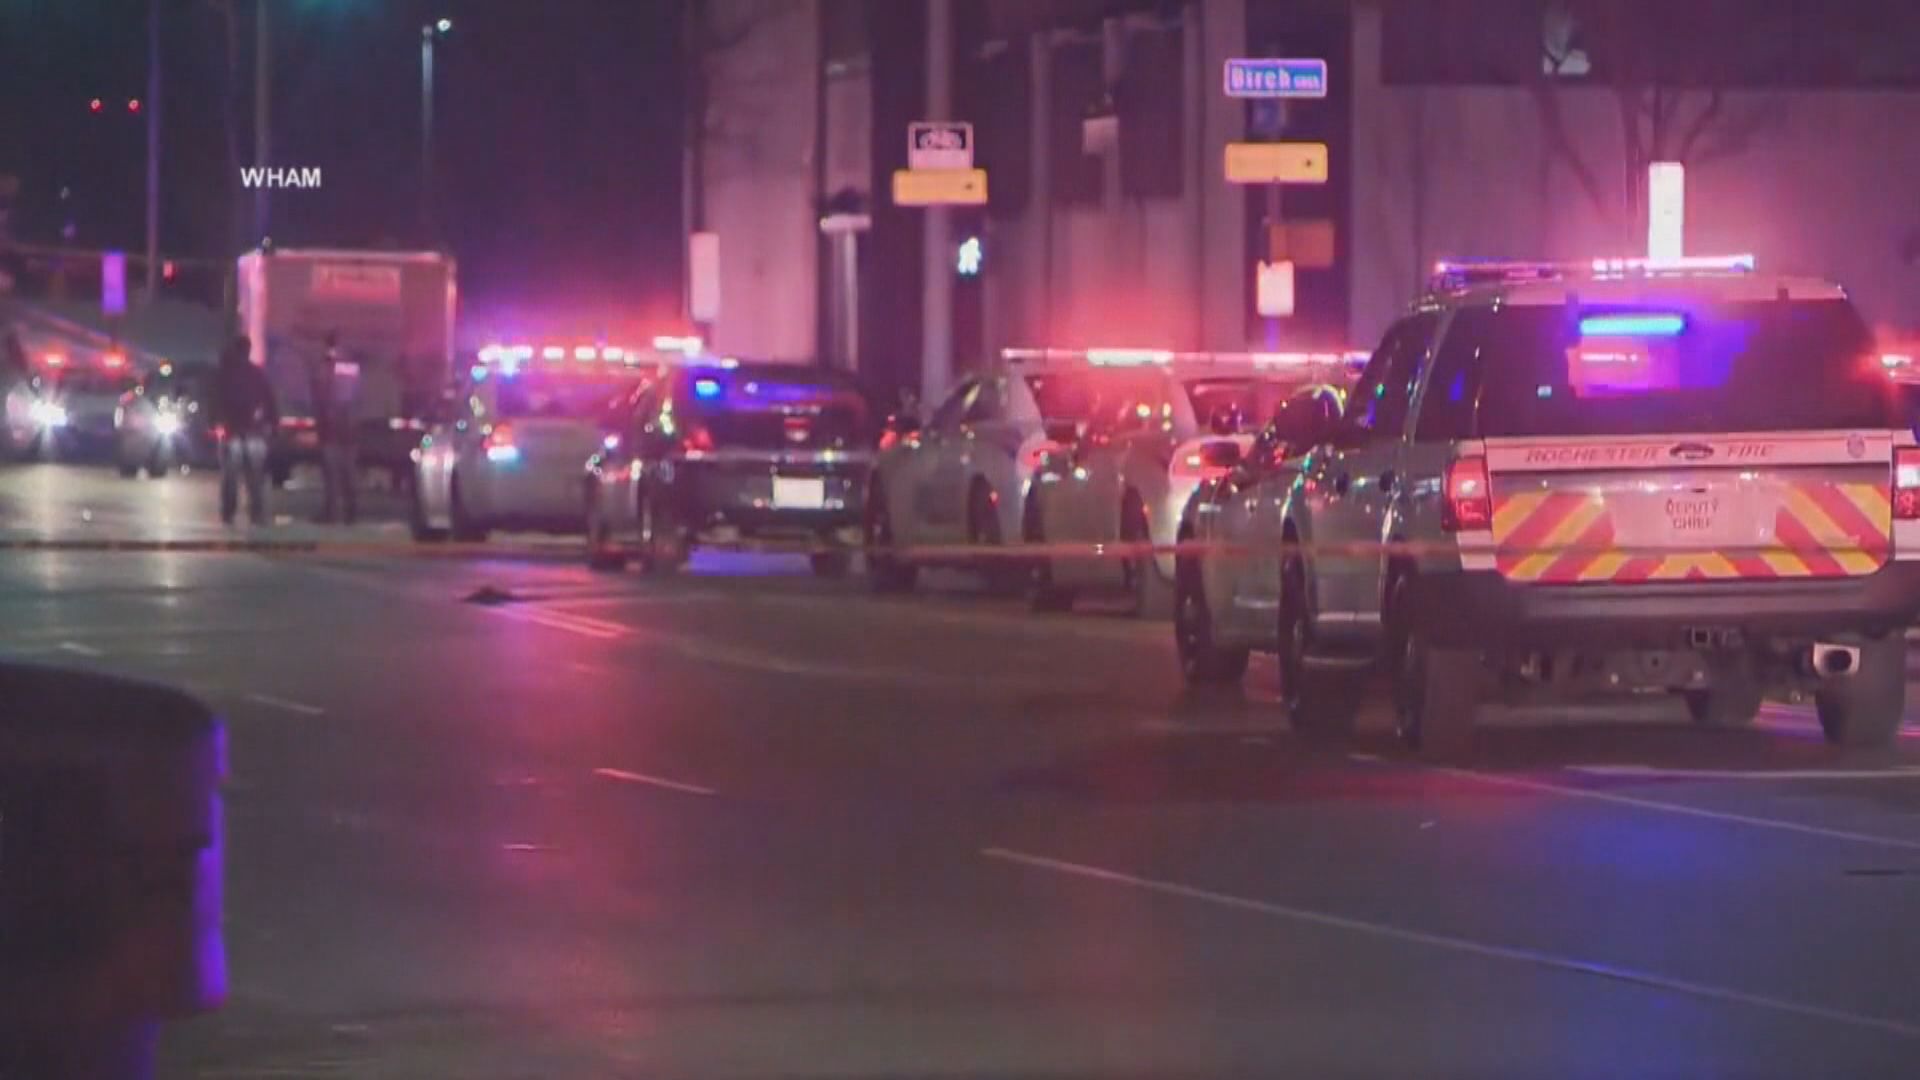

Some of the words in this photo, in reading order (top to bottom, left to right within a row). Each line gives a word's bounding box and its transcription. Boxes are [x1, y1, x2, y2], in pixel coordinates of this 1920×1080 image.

[1231, 67, 1291, 90] Birch
[1525, 446, 1660, 463] ROCHESTER
[1727, 442, 1775, 457] FIRE
[1665, 498, 1720, 514] DEPUTY
[1672, 517, 1711, 529] CHIEF
